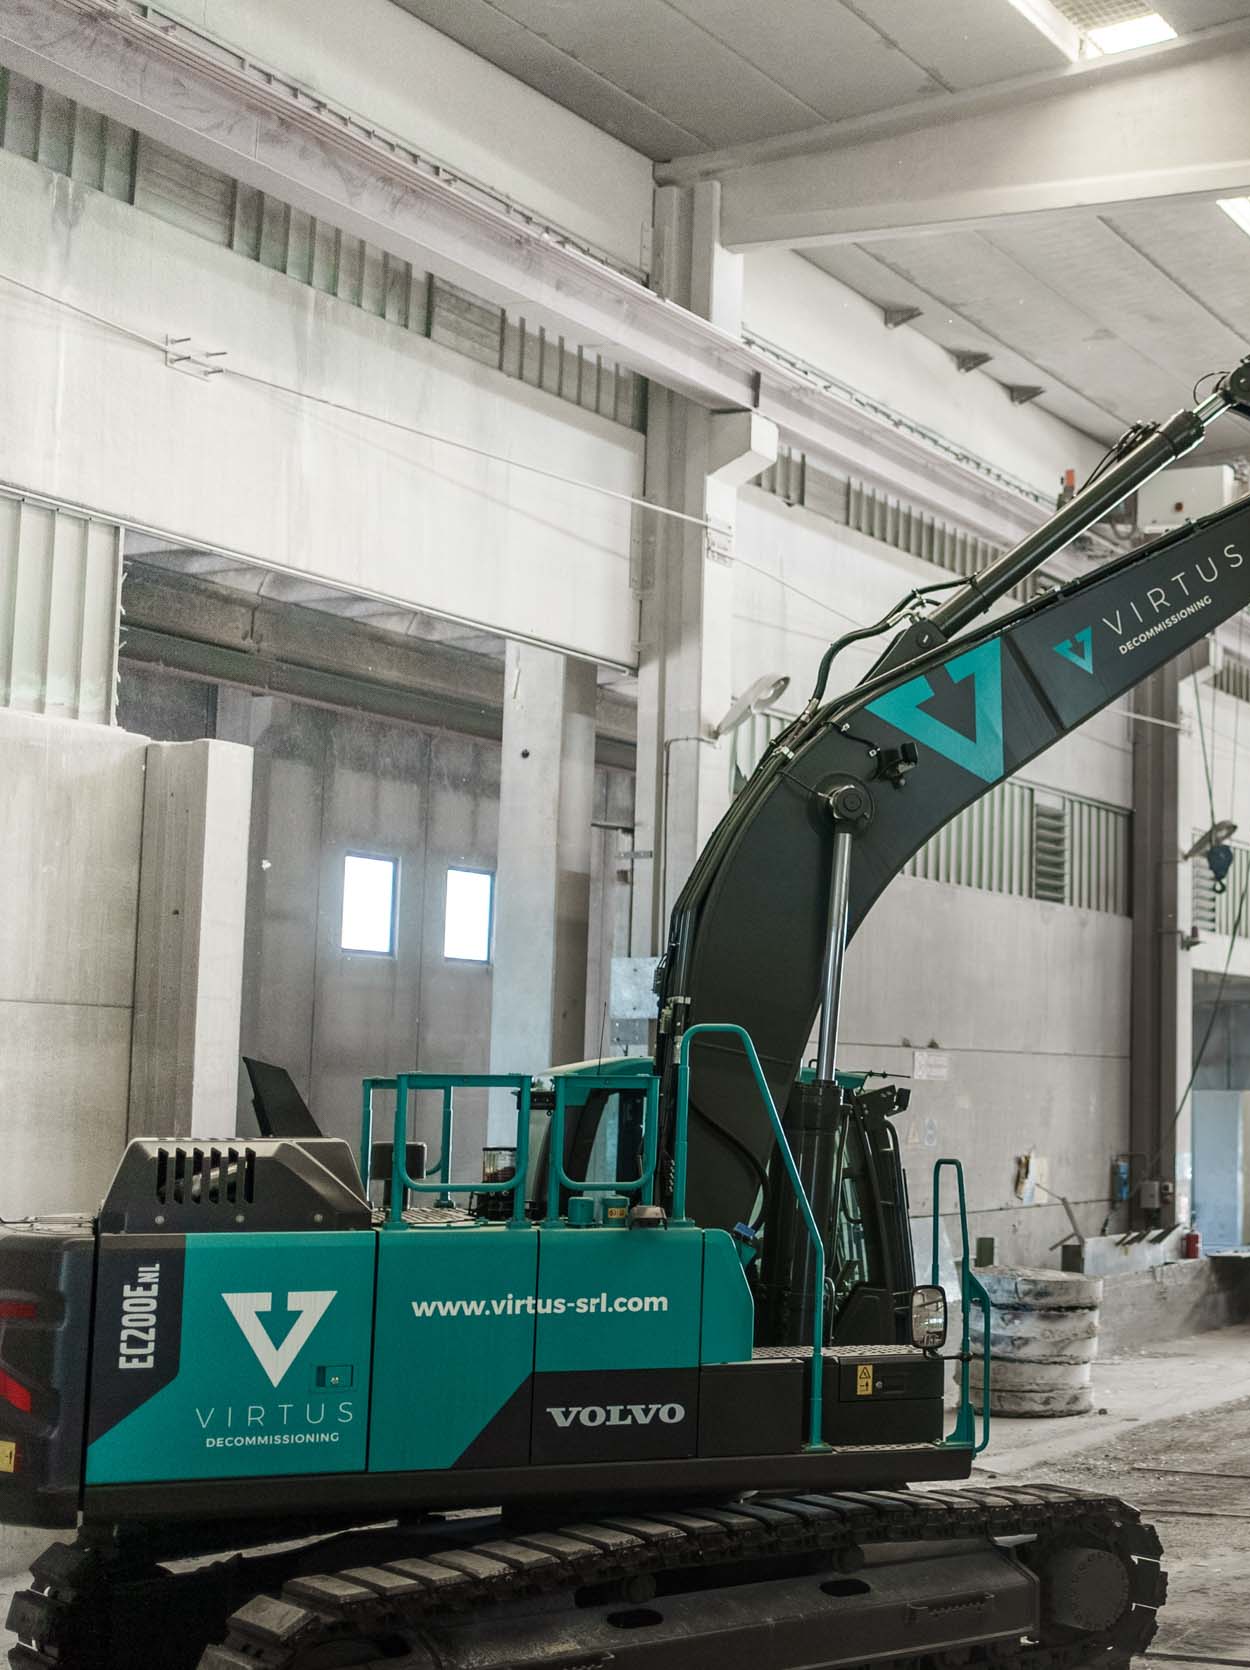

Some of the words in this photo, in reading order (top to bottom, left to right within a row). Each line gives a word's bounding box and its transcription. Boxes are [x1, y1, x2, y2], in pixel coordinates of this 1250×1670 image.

[1102, 544, 1243, 635] VIRTUS
[1118, 595, 1212, 655] DECOMMISSIONING
[411, 1293, 668, 1317] www.virtus-srl.com
[196, 1402, 353, 1429] VIRTUS
[546, 1403, 686, 1428] VOLVO
[205, 1432, 339, 1448] DECOMMISSIONING
